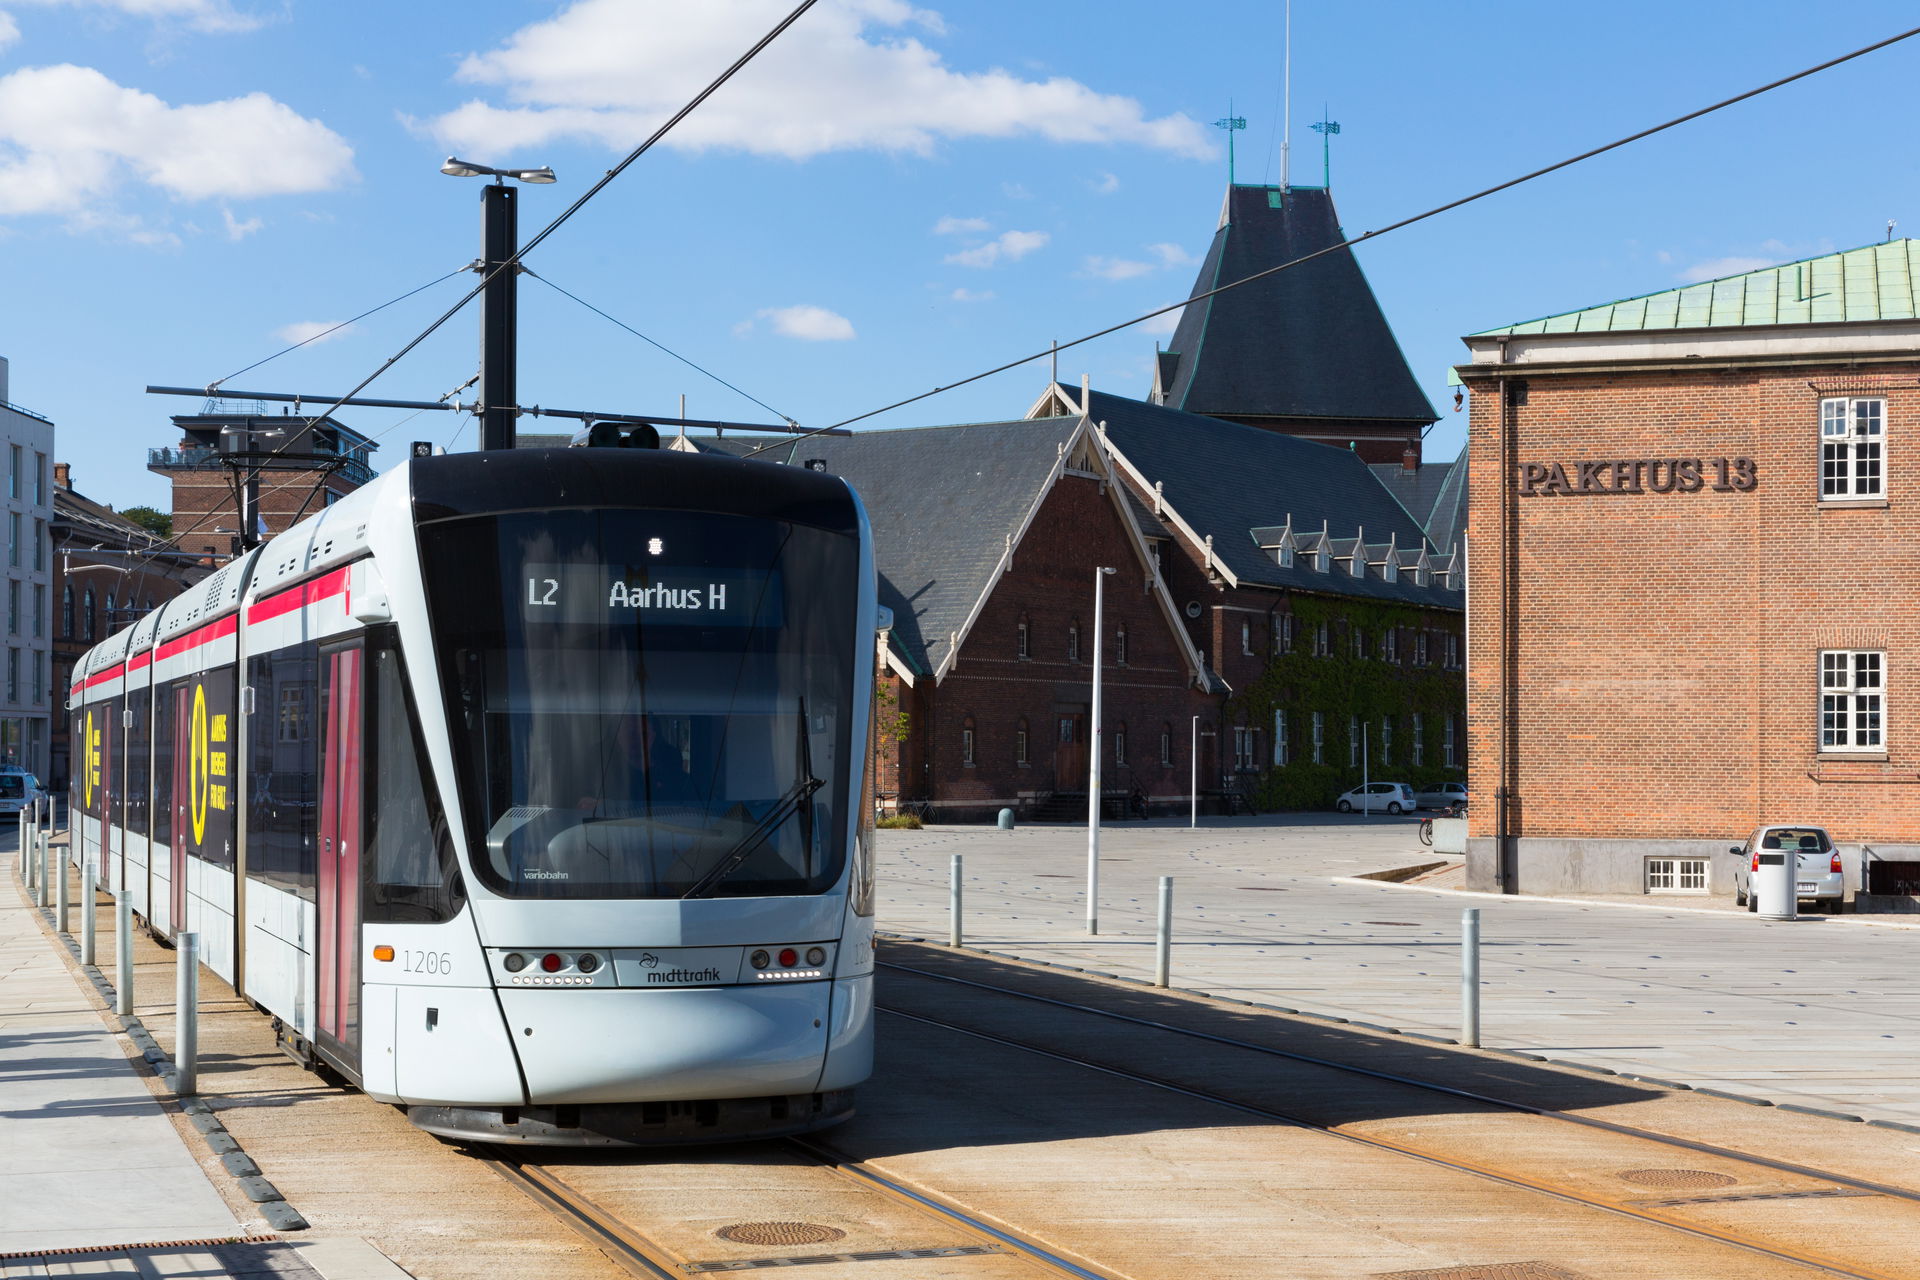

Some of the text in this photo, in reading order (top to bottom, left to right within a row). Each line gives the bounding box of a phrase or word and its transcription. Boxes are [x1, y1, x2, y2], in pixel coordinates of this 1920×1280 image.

[1518, 456, 1757, 496] PAKHUS 13
[529, 578, 726, 610] L2 Aarhus H
[524, 871, 569, 880] variobahn
[403, 950, 452, 975] 1206
[647, 967, 722, 983] midttrafik
